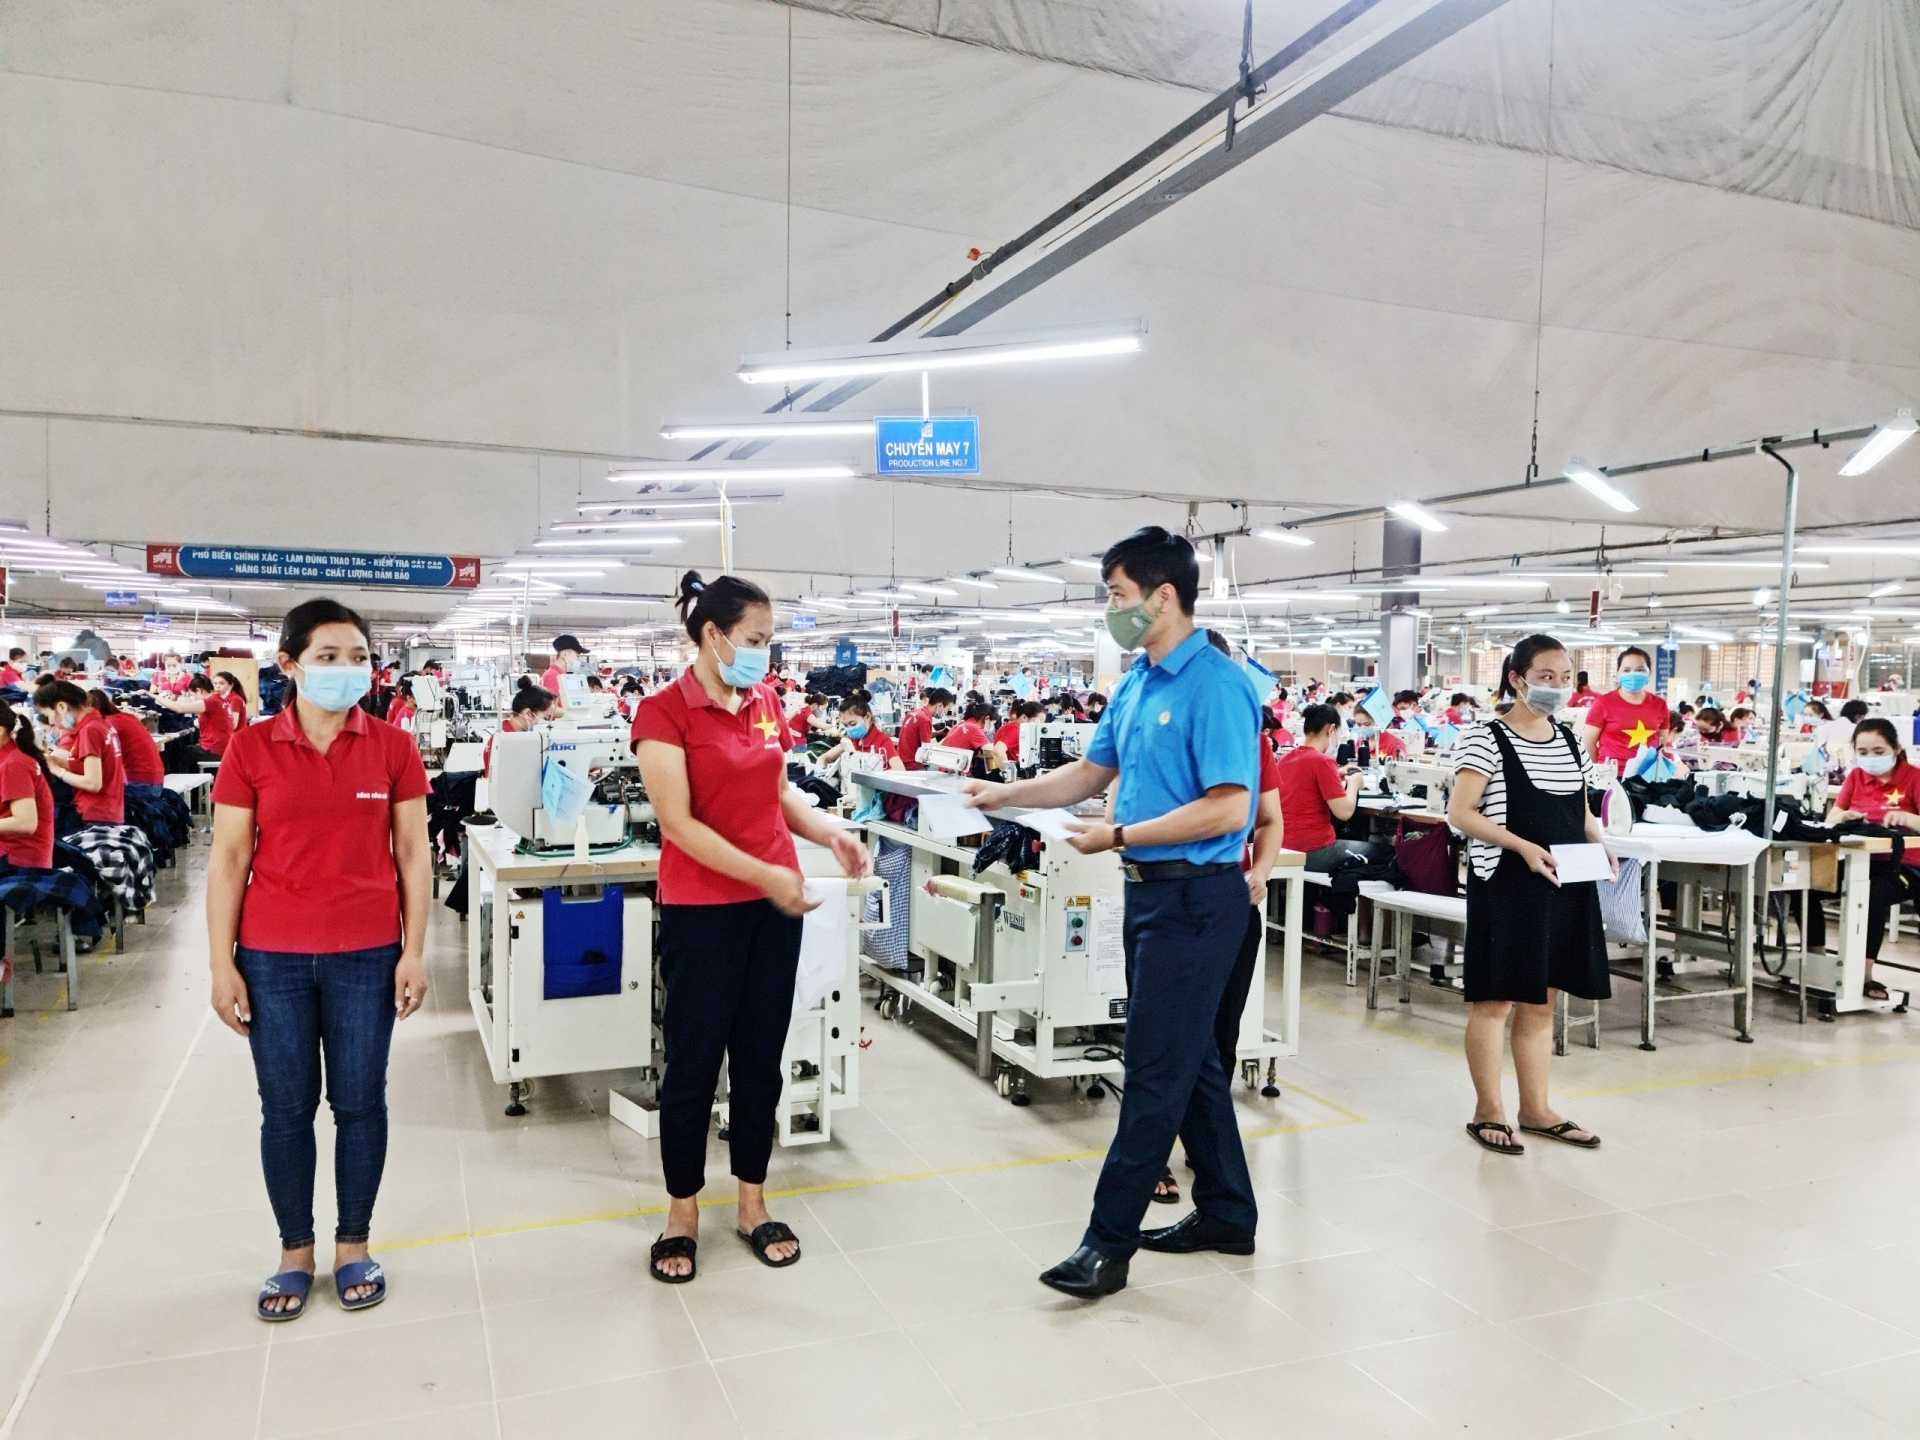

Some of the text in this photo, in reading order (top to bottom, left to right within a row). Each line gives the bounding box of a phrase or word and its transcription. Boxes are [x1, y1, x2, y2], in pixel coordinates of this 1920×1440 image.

[935, 442, 961, 455] MAY
[963, 442, 970, 455] 7
[888, 459, 934, 467] PRODUCTION
[935, 459, 951, 467] LINE
[211, 548, 231, 560] BIẾN
[233, 550, 260, 561] CHÍNH
[261, 552, 278, 562] XÁC
[329, 556, 350, 565] THAO
[394, 559, 410, 568] TRA
[284, 565, 300, 576] LÊN
[301, 567, 318, 577] CAO
